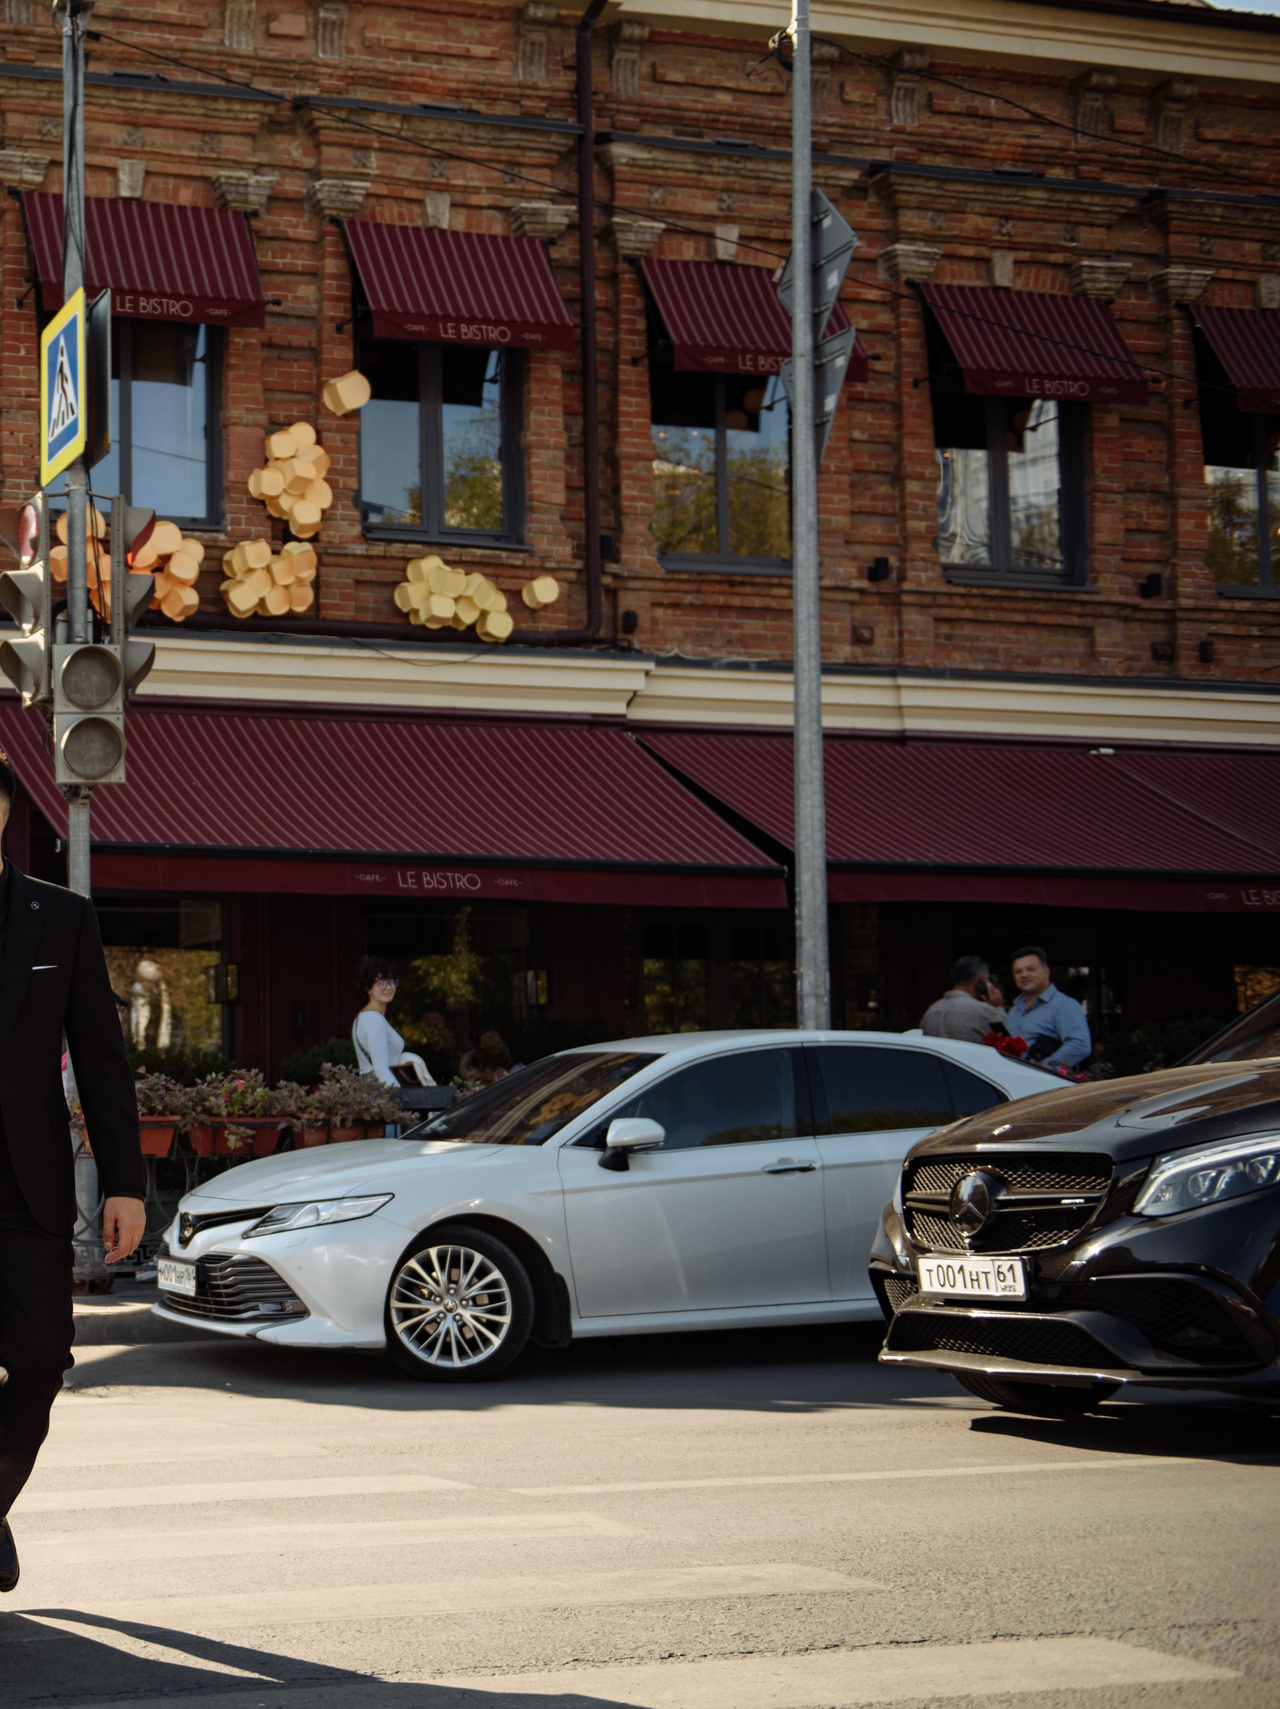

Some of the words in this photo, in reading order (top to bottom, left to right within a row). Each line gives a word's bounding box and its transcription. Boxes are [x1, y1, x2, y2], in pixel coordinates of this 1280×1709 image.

[116, 295, 135, 312] LE
[139, 297, 194, 317] BISTRO
[439, 323, 457, 338] LE
[460, 323, 511, 342] BISTRO
[738, 354, 754, 370] LE
[758, 355, 788, 372] BIST
[1025, 378, 1041, 394] LE
[1044, 379, 1090, 396] BISTRO
[397, 871, 418, 888] LE
[422, 871, 482, 890] BISTRO
[1241, 889, 1262, 905] LE
